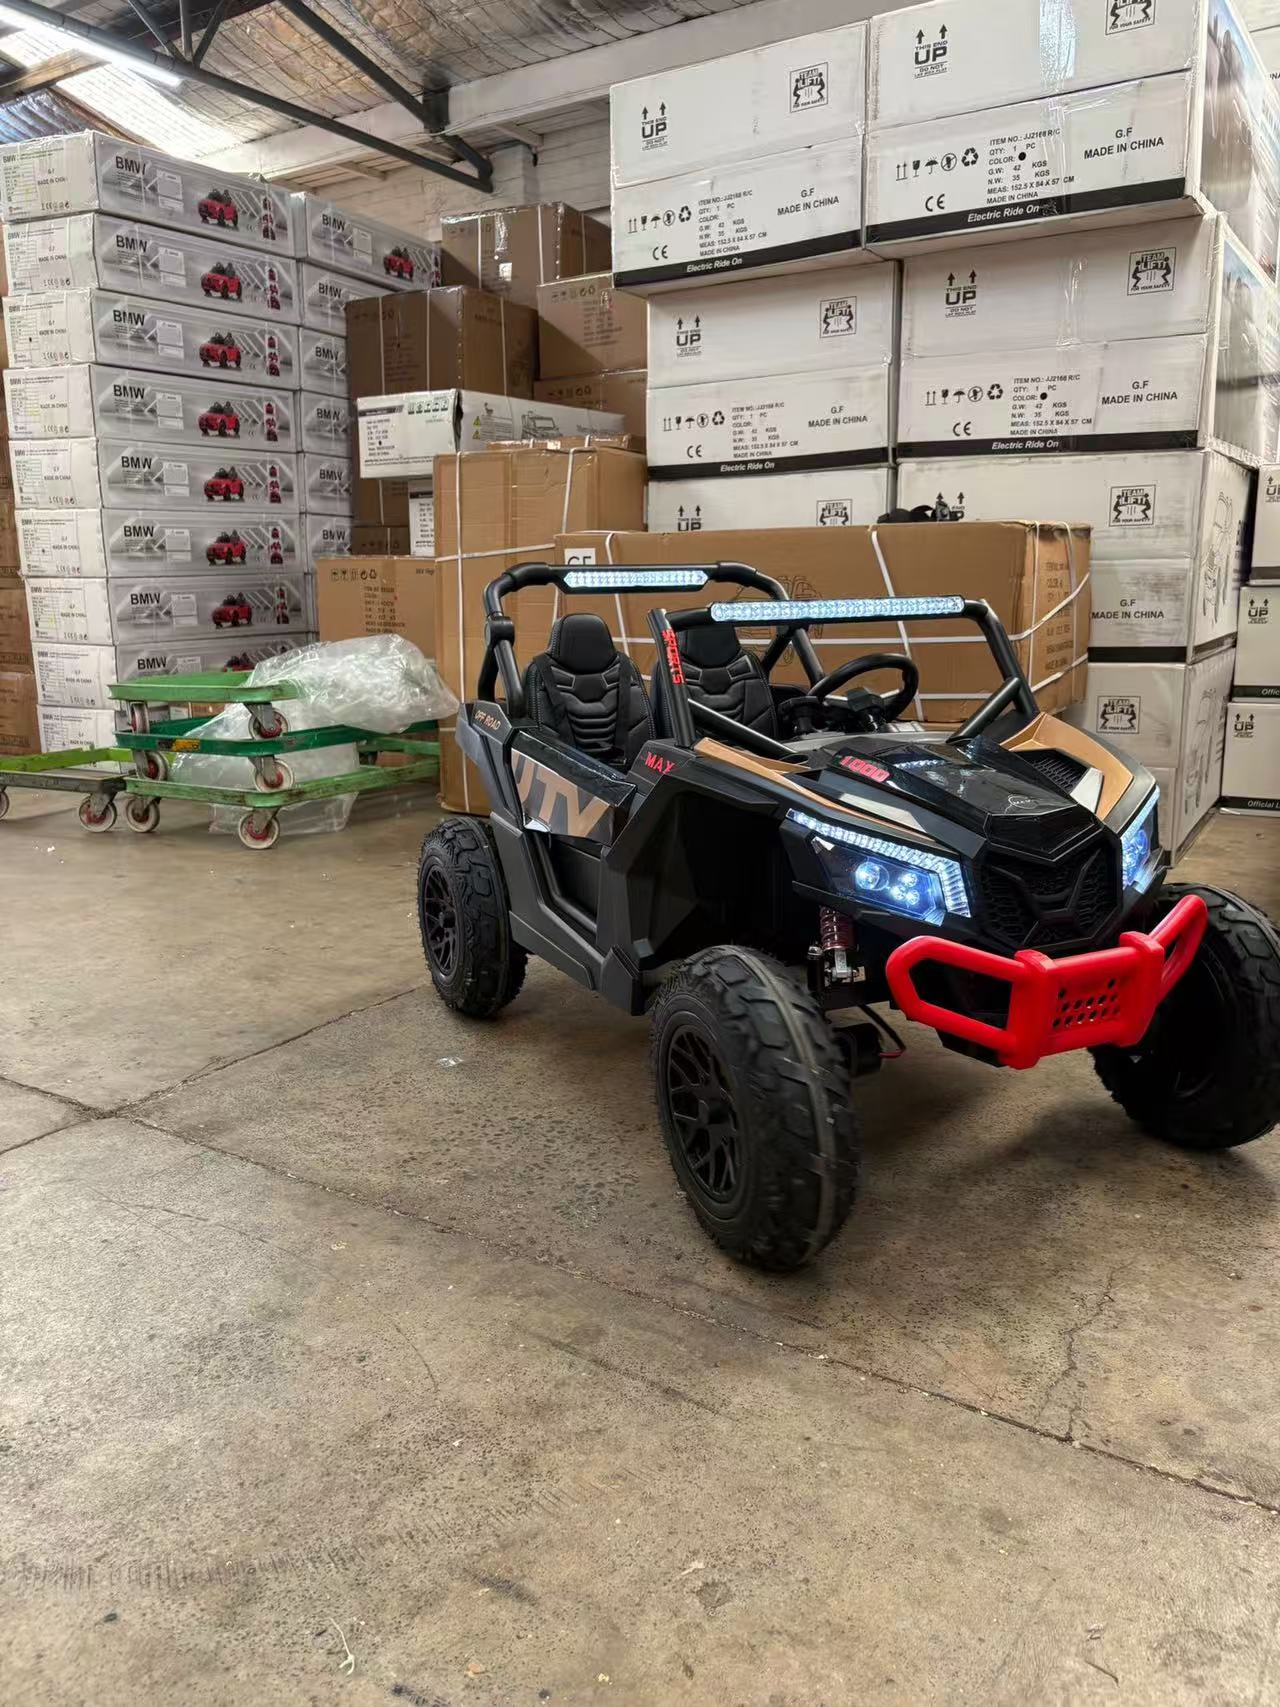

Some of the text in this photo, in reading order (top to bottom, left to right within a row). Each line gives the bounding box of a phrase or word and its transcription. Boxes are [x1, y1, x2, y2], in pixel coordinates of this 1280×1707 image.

[915, 46, 947, 65] UP
[642, 122, 667, 138] UP
[1115, 127, 1133, 138] G.F
[989, 138, 1006, 146] ITEM
[1084, 137, 1164, 159] MADE IN CHINA
[989, 148, 1005, 156] QTY:
[115, 156, 146, 175] BMW
[988, 156, 1015, 165] COLOR:
[1032, 160, 1047, 168] KGS
[987, 195, 1007, 204] MADE
[1016, 191, 1038, 200] CHINA
[777, 196, 839, 216] MADE IN CHINA
[967, 204, 1040, 223] Electric Ride On
[322, 214, 346, 231] BMW
[116, 235, 147, 253] BMW
[686, 257, 743, 272] Electric Ride On
[318, 282, 342, 299] BMW
[946, 290, 976, 305] UP
[113, 309, 145, 326] BMW
[677, 334, 701, 346] UP
[315, 346, 339, 361] BMW
[113, 384, 145, 399] BMW
[1132, 380, 1149, 390] G.F
[1101, 392, 1177, 405] MADE IN CHINA
[316, 407, 340, 421] BMW
[808, 415, 868, 428] MADE IN CHINA
[991, 439, 1059, 450] Electric Ride On
[121, 456, 152, 469] BMW
[720, 461, 775, 472] Electric Ride On
[319, 469, 343, 481] BMW
[123, 525, 154, 537] BMW
[678, 522, 701, 531] UP
[322, 530, 346, 541] BMW
[130, 592, 161, 605] BMW
[1120, 599, 1136, 607] G.F
[1091, 611, 1164, 619] MADE IN CHINA
[1248, 609, 1268, 617] UP
[138, 657, 167, 670] BMW
[1234, 722, 1254, 731] UP
[645, 751, 677, 774] MAX
[840, 755, 890, 783] 1000
[511, 748, 610, 837] UTV
[1247, 800, 1274, 808] Official
